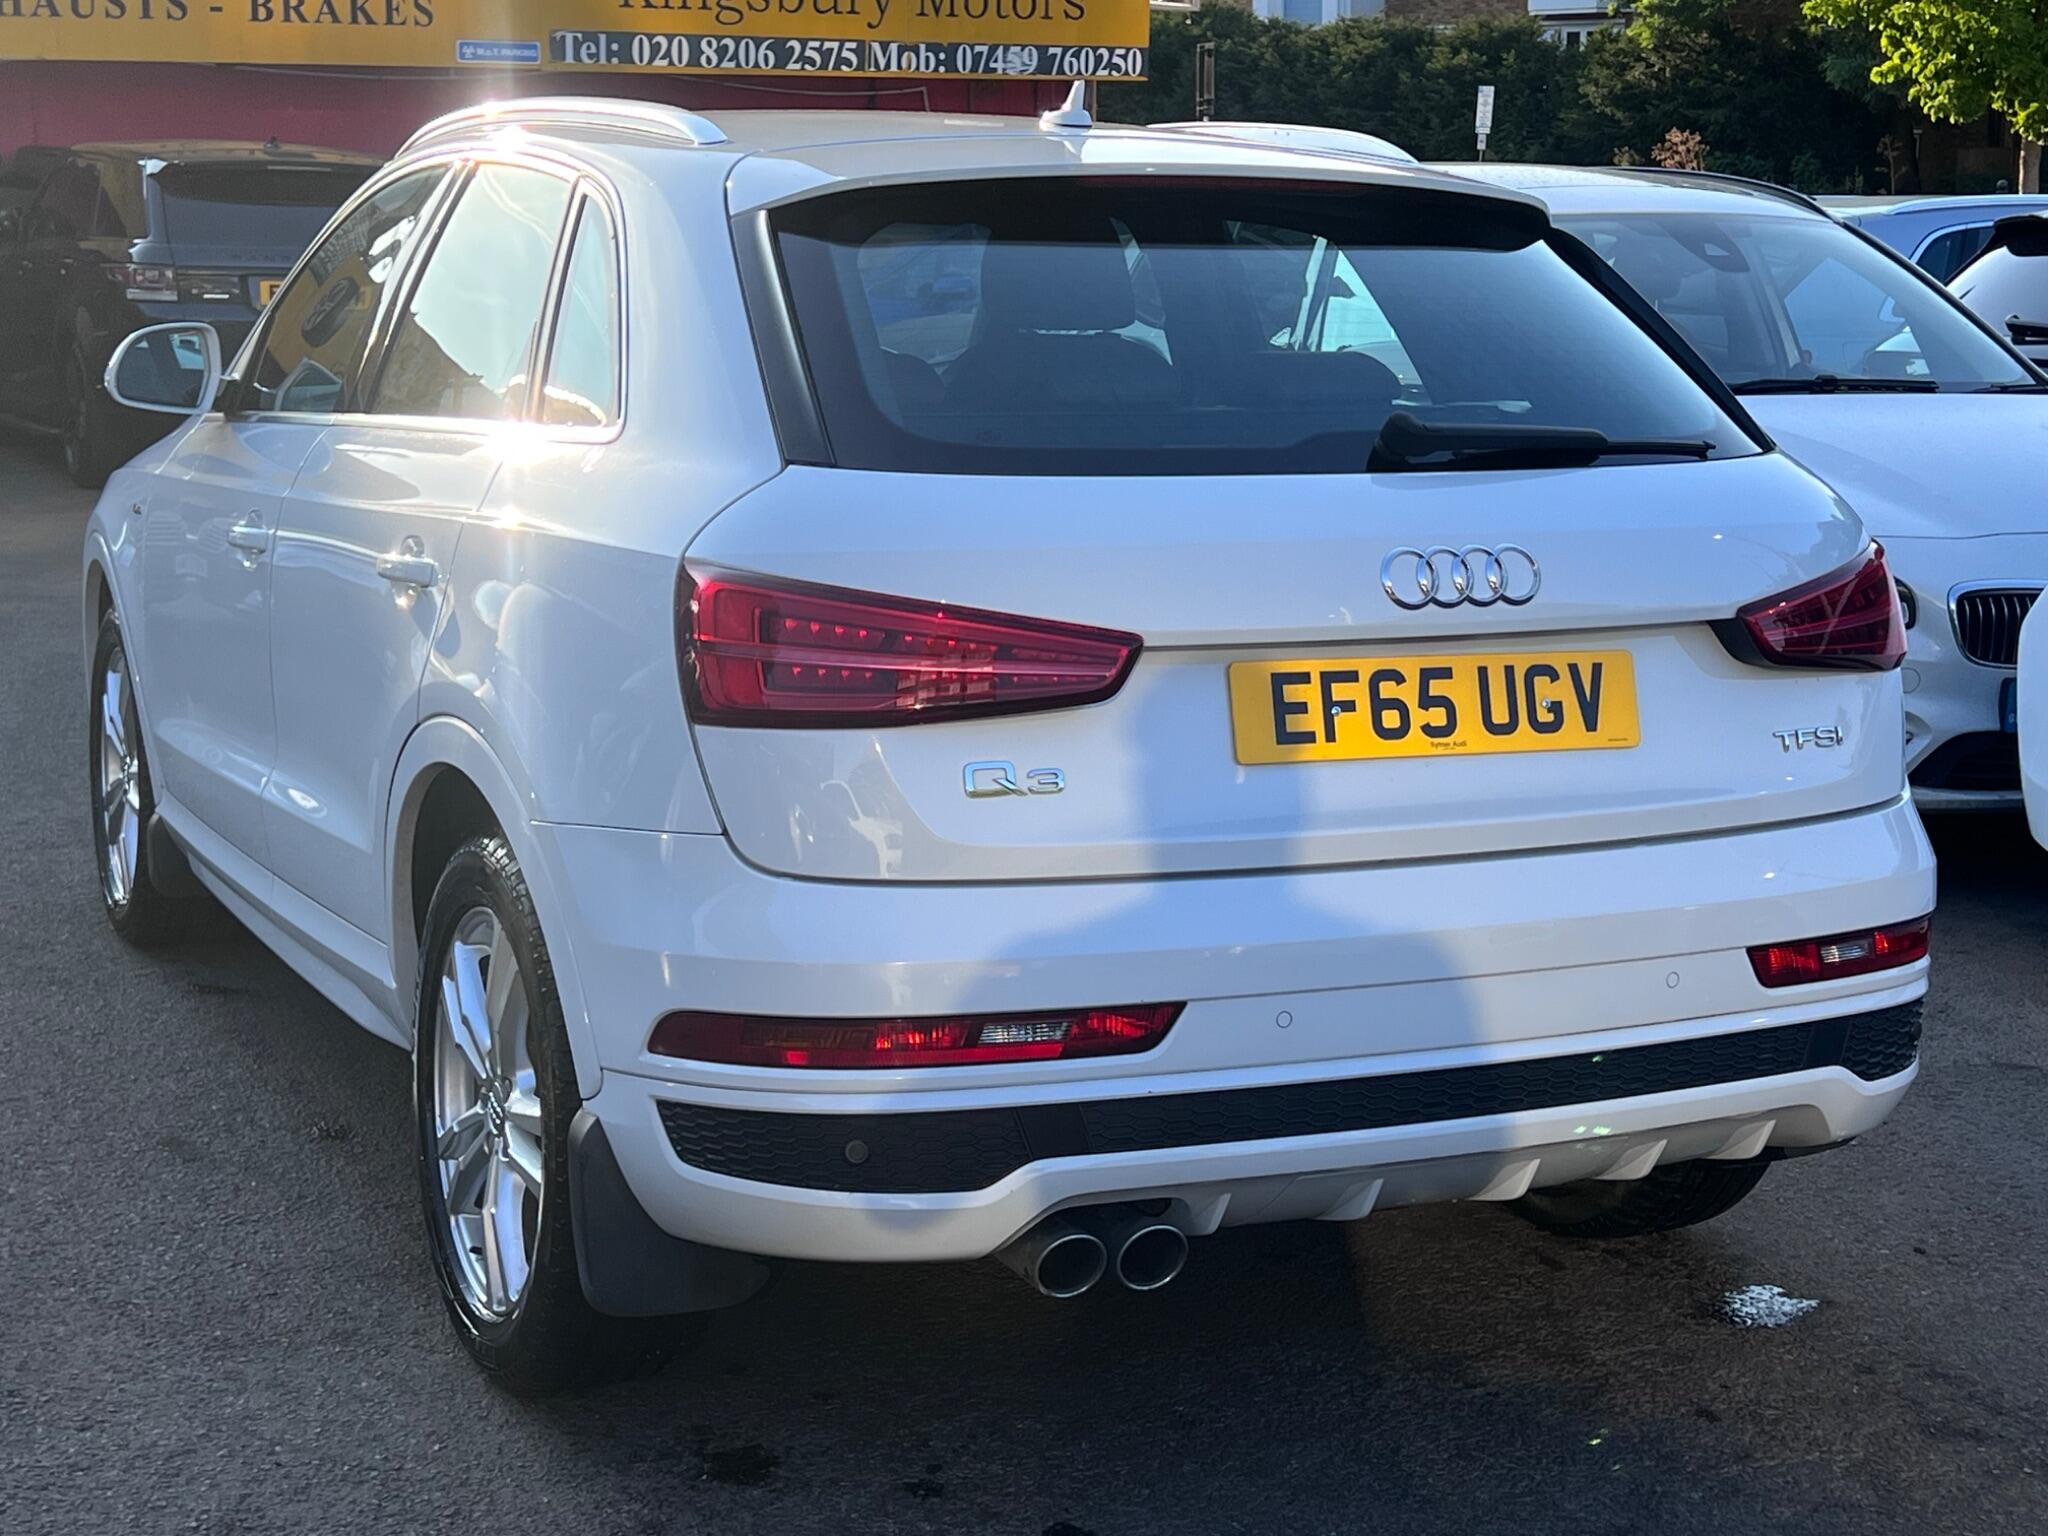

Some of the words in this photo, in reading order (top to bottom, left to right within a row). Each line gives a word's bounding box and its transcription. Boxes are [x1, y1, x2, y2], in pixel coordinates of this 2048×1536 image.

[248, 0, 434, 27] BRAKES
[555, 33, 620, 64] Tel:
[631, 34, 689, 67] 020
[699, 36, 776, 70] 8206
[784, 39, 858, 72] 2575
[868, 41, 946, 73] Mob:
[1047, 47, 1142, 77] 760250
[1270, 666, 1458, 745] EF65
[1477, 662, 1603, 736] UGV
[1772, 726, 1844, 754] TFSI
[962, 760, 1065, 799] Q3
